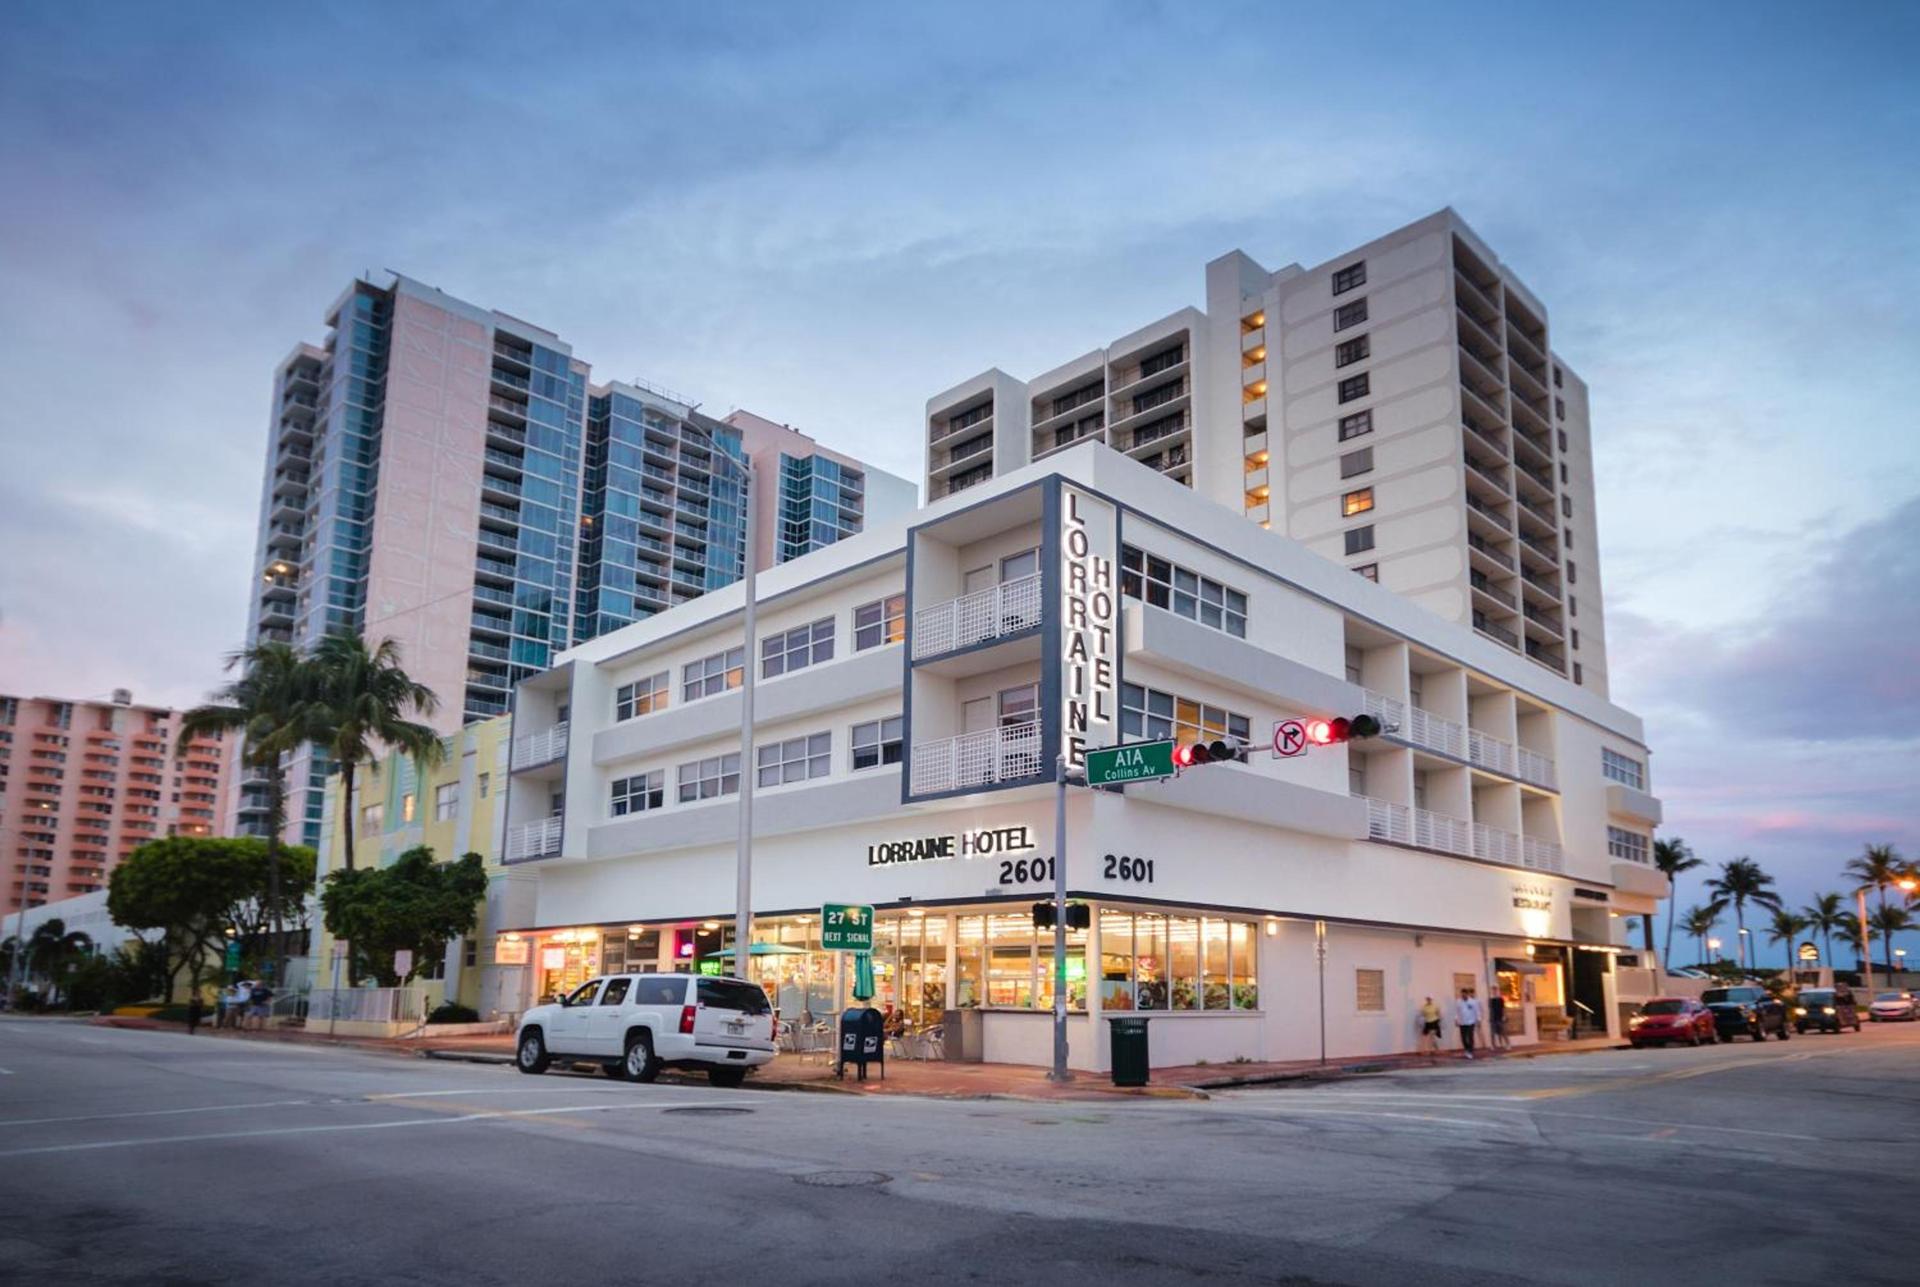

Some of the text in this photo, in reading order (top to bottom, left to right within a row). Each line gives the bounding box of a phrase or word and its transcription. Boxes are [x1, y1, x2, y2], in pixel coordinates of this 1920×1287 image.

[1067, 494, 1088, 767] LORRAINE
[1092, 556, 1111, 721] HOTEL
[1115, 749, 1144, 767] A1A
[1105, 765, 1156, 780] Collins Av
[868, 827, 1035, 866] LORRAINE HOTEL
[999, 857, 1056, 884] 2601
[1104, 854, 1154, 883] 2601
[828, 911, 868, 926] 27 ST
[824, 932, 870, 943] NEXT SIGNAL
